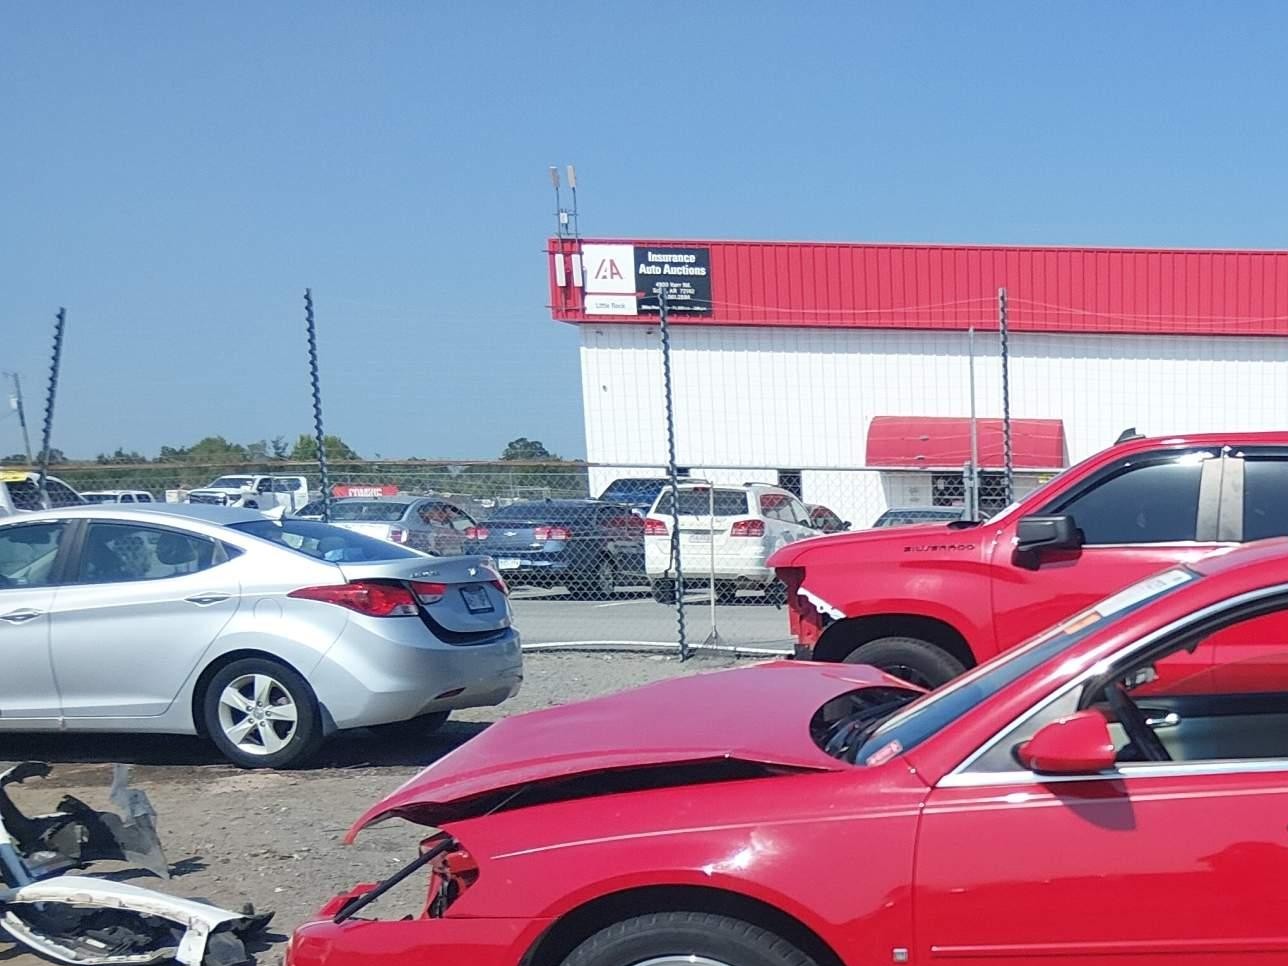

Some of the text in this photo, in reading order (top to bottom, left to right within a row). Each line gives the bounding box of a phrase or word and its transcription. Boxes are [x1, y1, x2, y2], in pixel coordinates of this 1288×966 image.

[648, 251, 696, 262] Insurance
[638, 263, 707, 276] Auto Auctions
[903, 544, 976, 553] SILVERADO
